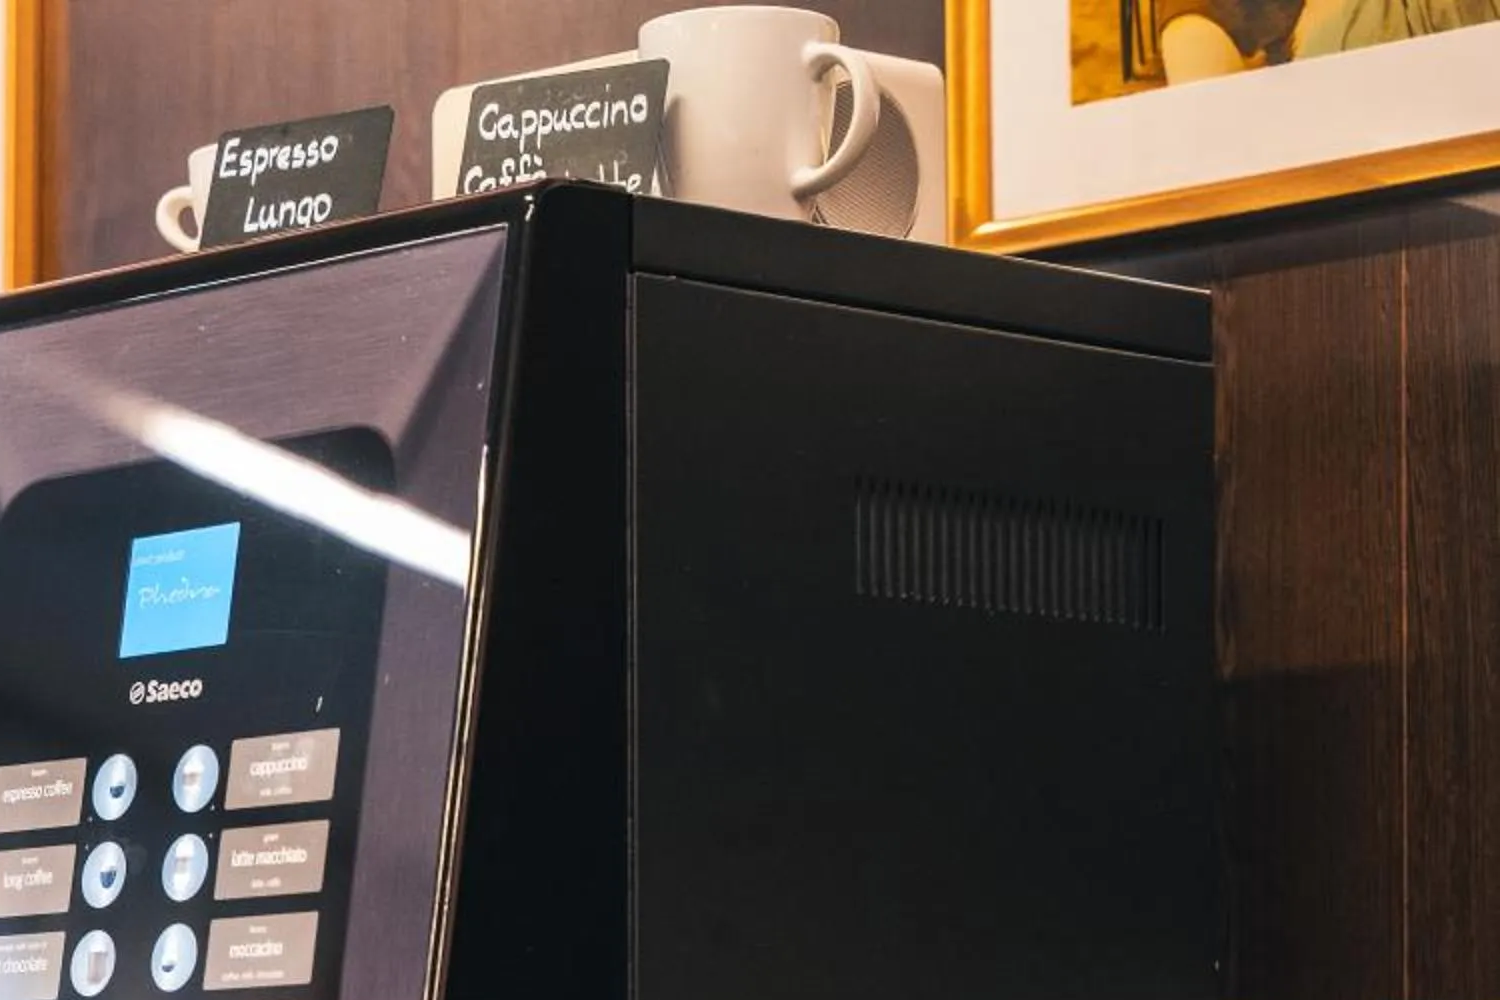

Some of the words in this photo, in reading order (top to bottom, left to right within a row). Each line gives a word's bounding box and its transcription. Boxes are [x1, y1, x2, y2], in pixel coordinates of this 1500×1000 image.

[479, 84, 647, 152] Cappuccino
[219, 135, 339, 186] Espresso
[243, 193, 333, 233] Lungo
[145, 677, 203, 703] Saeco
